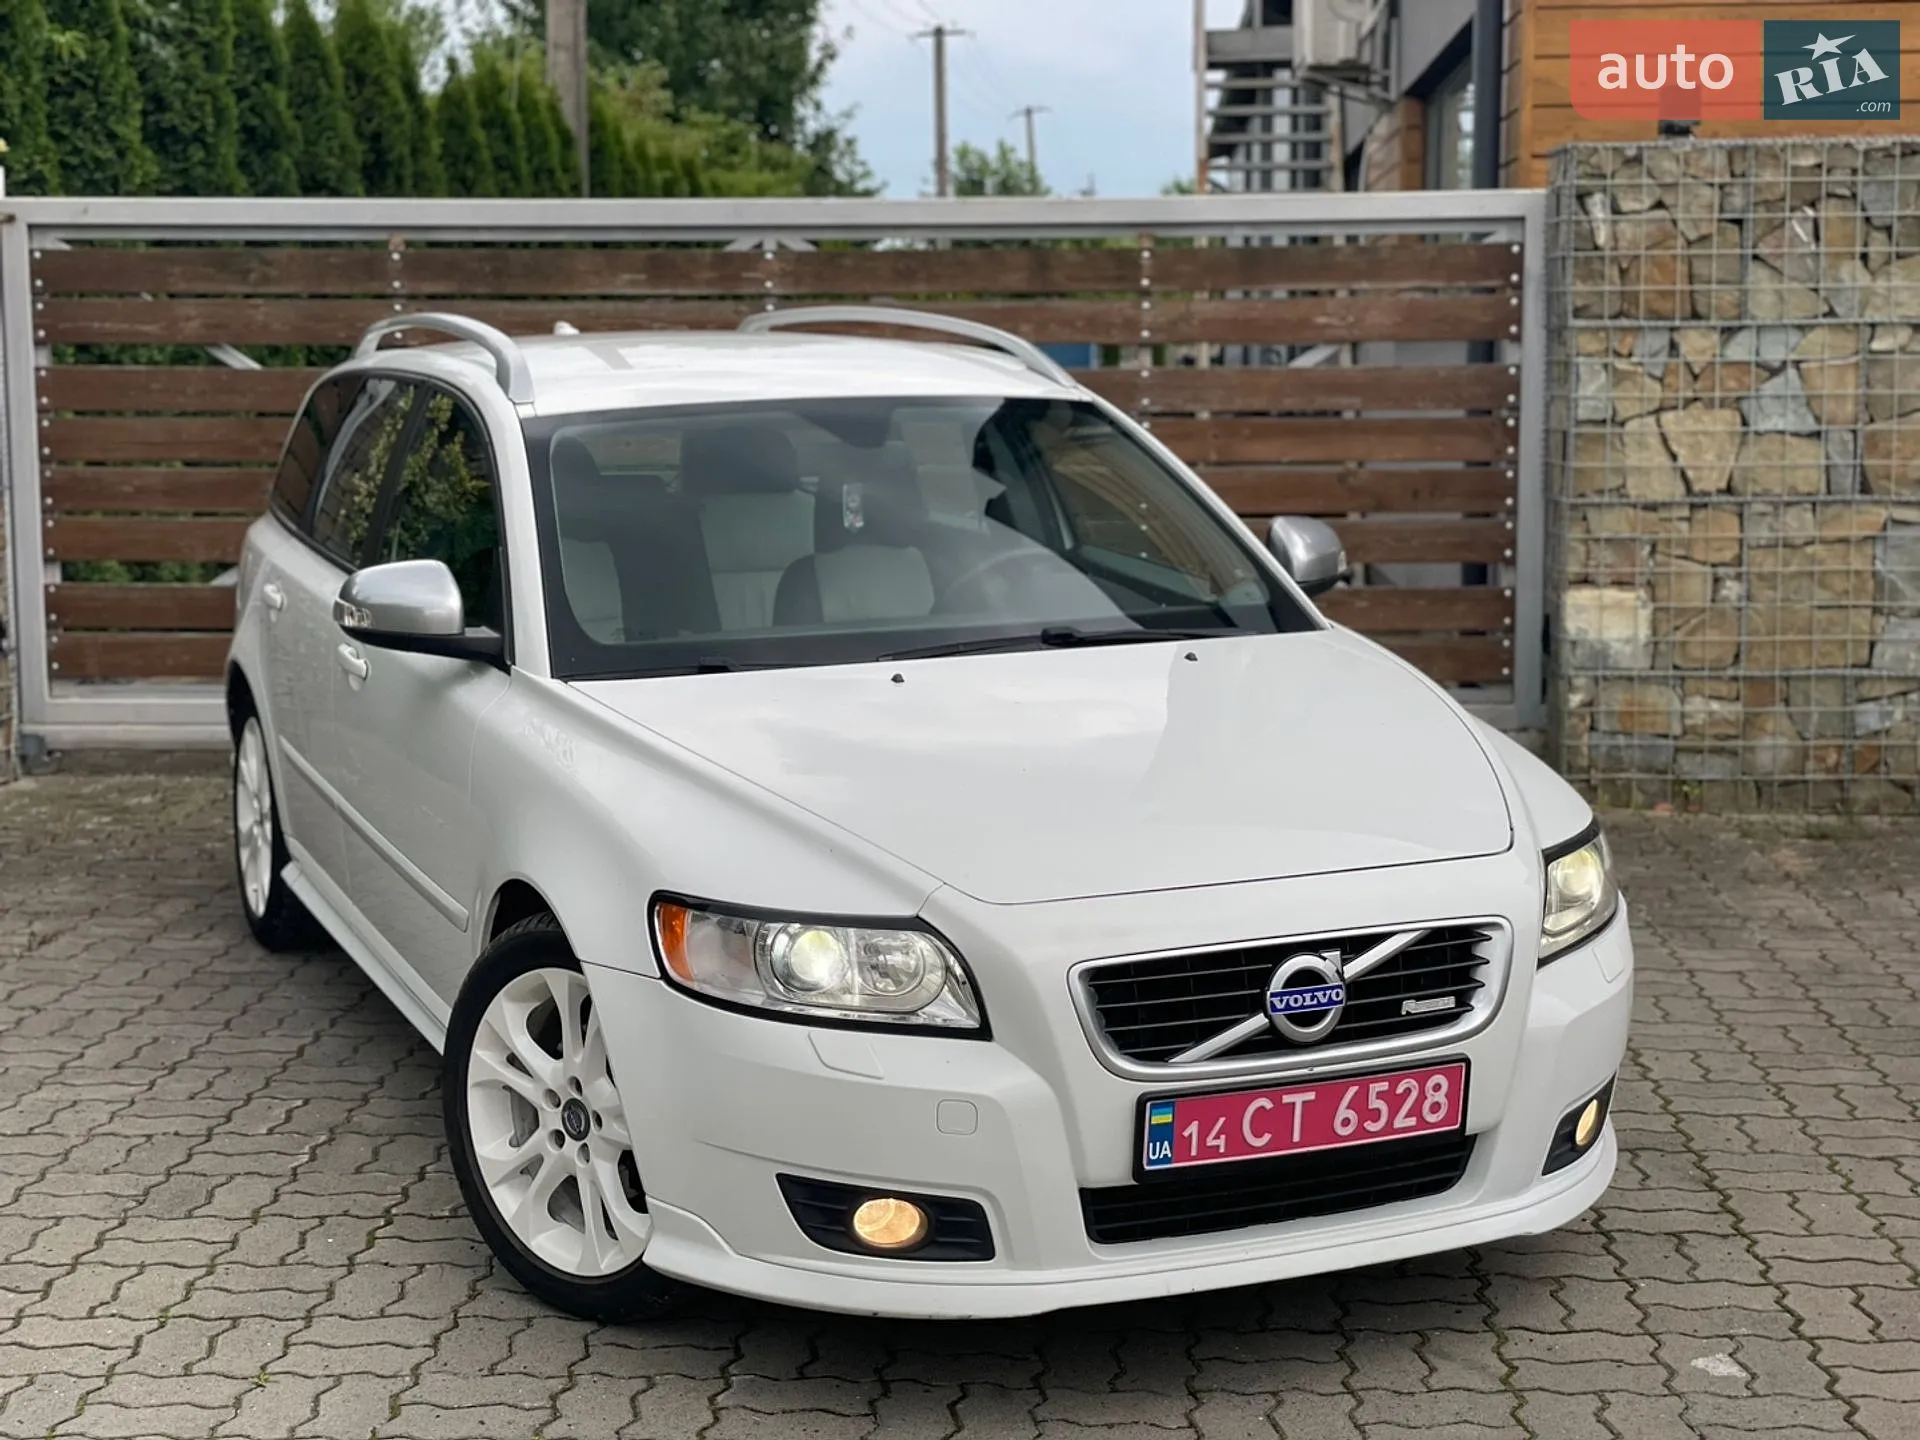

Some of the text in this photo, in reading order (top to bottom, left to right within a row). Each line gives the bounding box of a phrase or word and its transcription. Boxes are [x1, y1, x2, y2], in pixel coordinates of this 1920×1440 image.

[1271, 987, 1344, 1010] VOLVO
[1182, 1074, 1449, 1156] 14 CT 6528
[1149, 1141, 1172, 1159] UA
